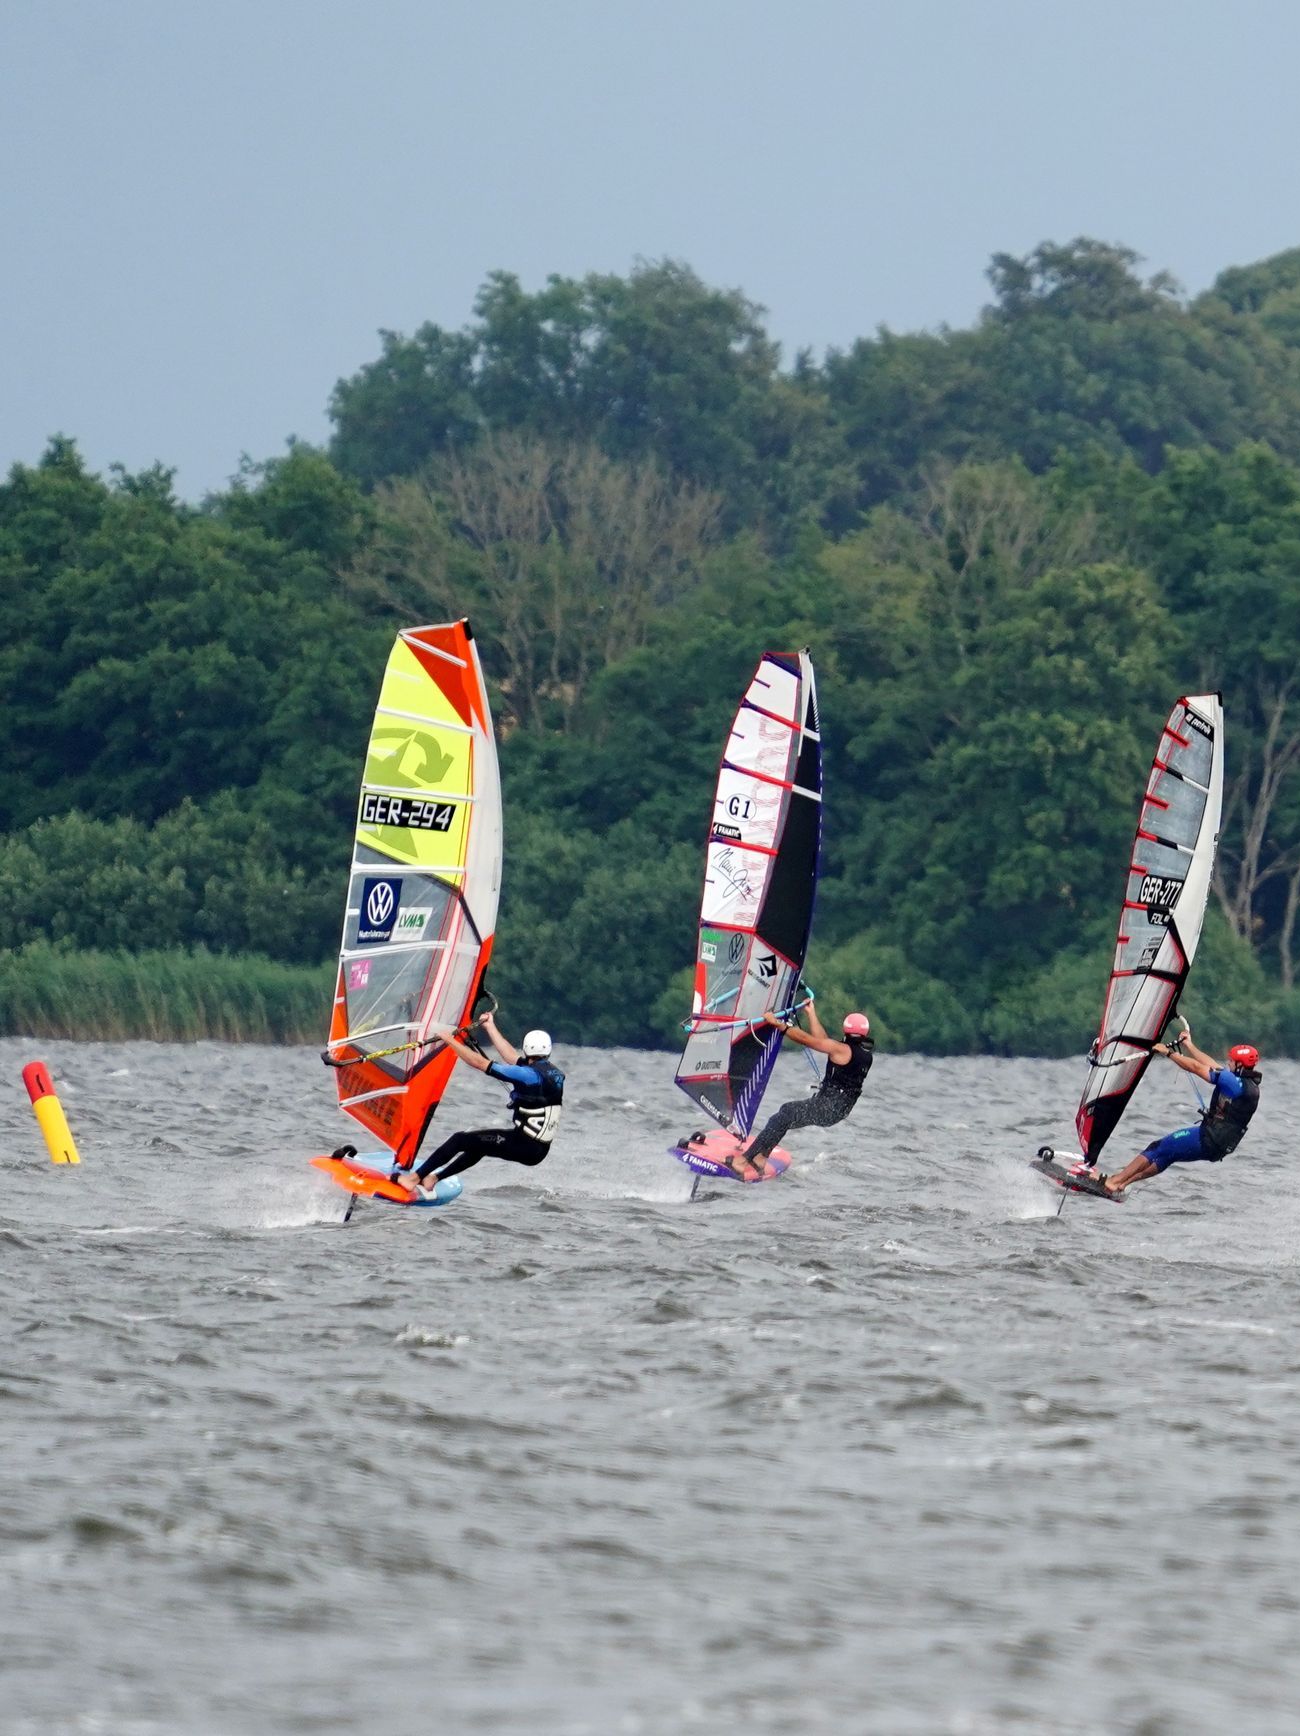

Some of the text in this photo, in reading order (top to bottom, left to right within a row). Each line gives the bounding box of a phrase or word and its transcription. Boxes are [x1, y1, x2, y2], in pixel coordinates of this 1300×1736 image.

[362, 795, 452, 830] GER-294
[1140, 876, 1182, 908] GER-277
[689, 1155, 718, 1172] FANATIC
